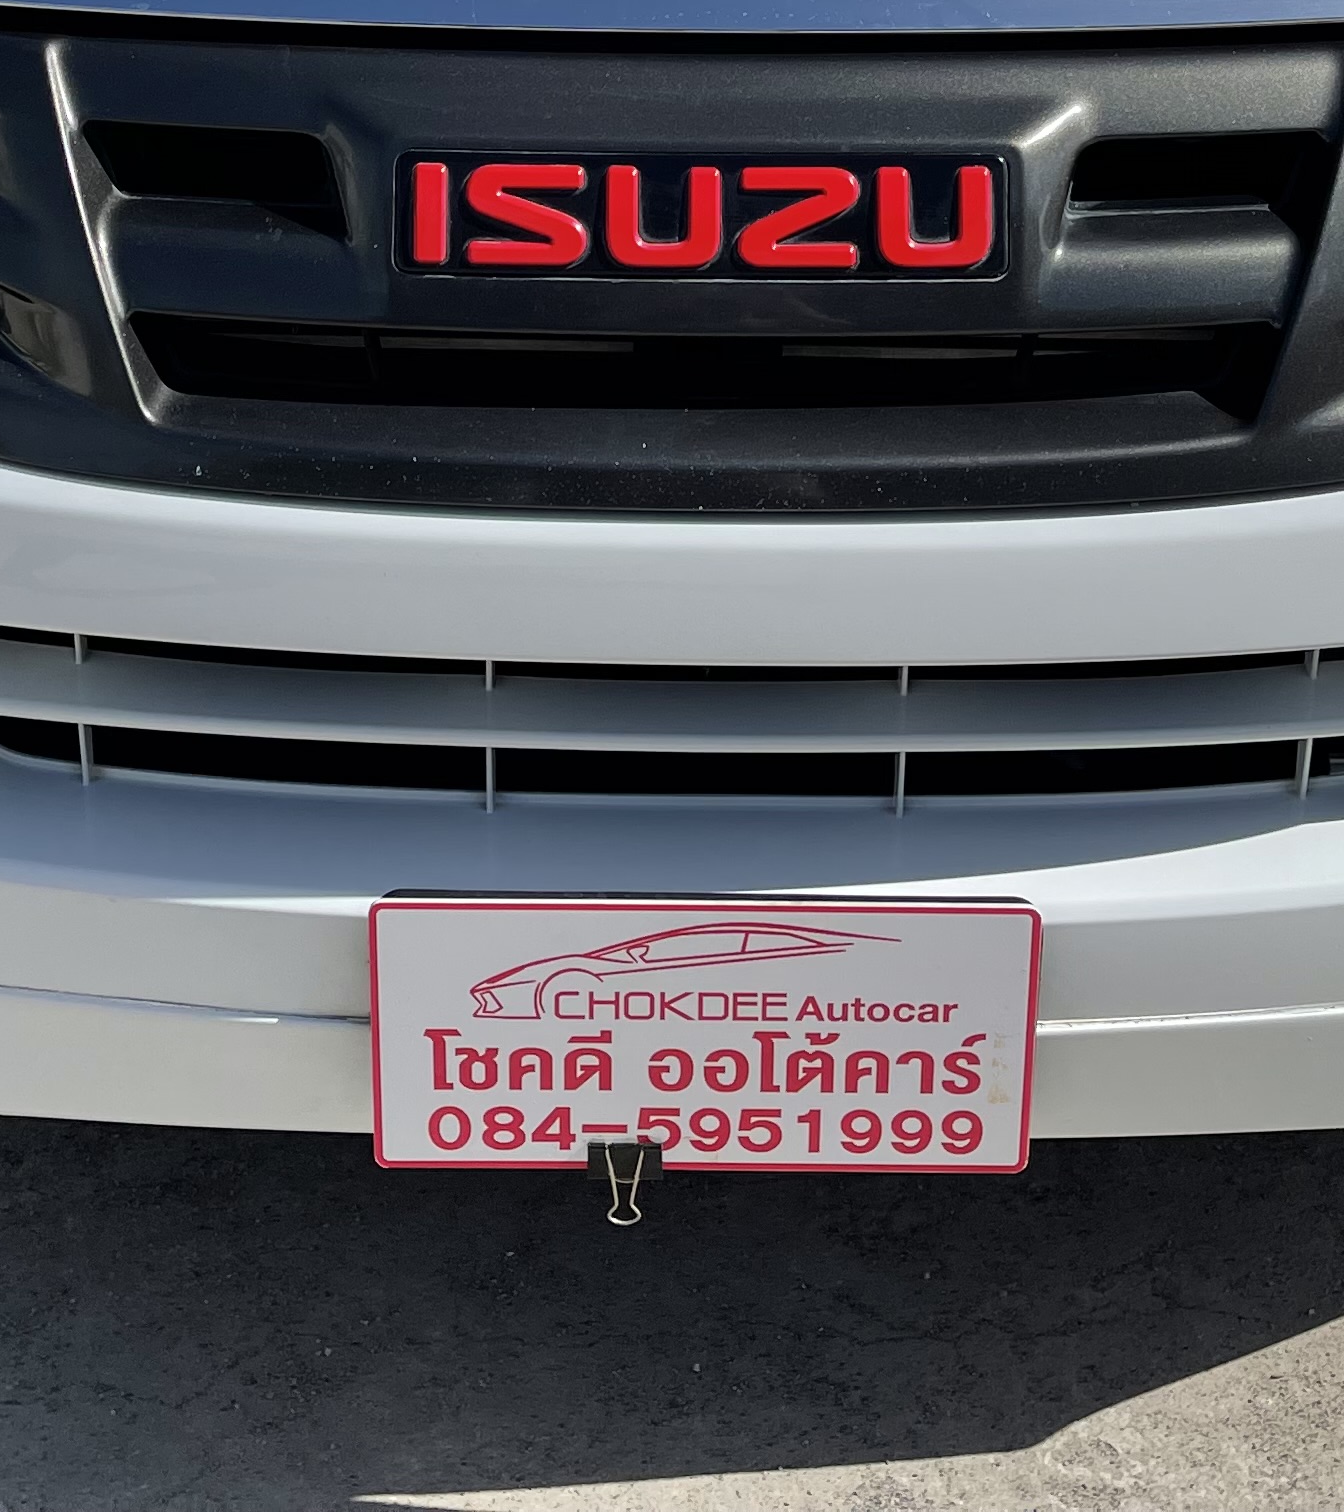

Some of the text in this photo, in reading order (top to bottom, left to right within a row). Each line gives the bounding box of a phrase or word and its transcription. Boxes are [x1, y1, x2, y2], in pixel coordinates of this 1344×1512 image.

[413, 162, 993, 271] ISUZU
[552, 990, 960, 1024] CHOKDEE Autocar
[423, 1028, 988, 1096] โชคดี ออโต้คาร์
[427, 1105, 985, 1156] 084-5951999
